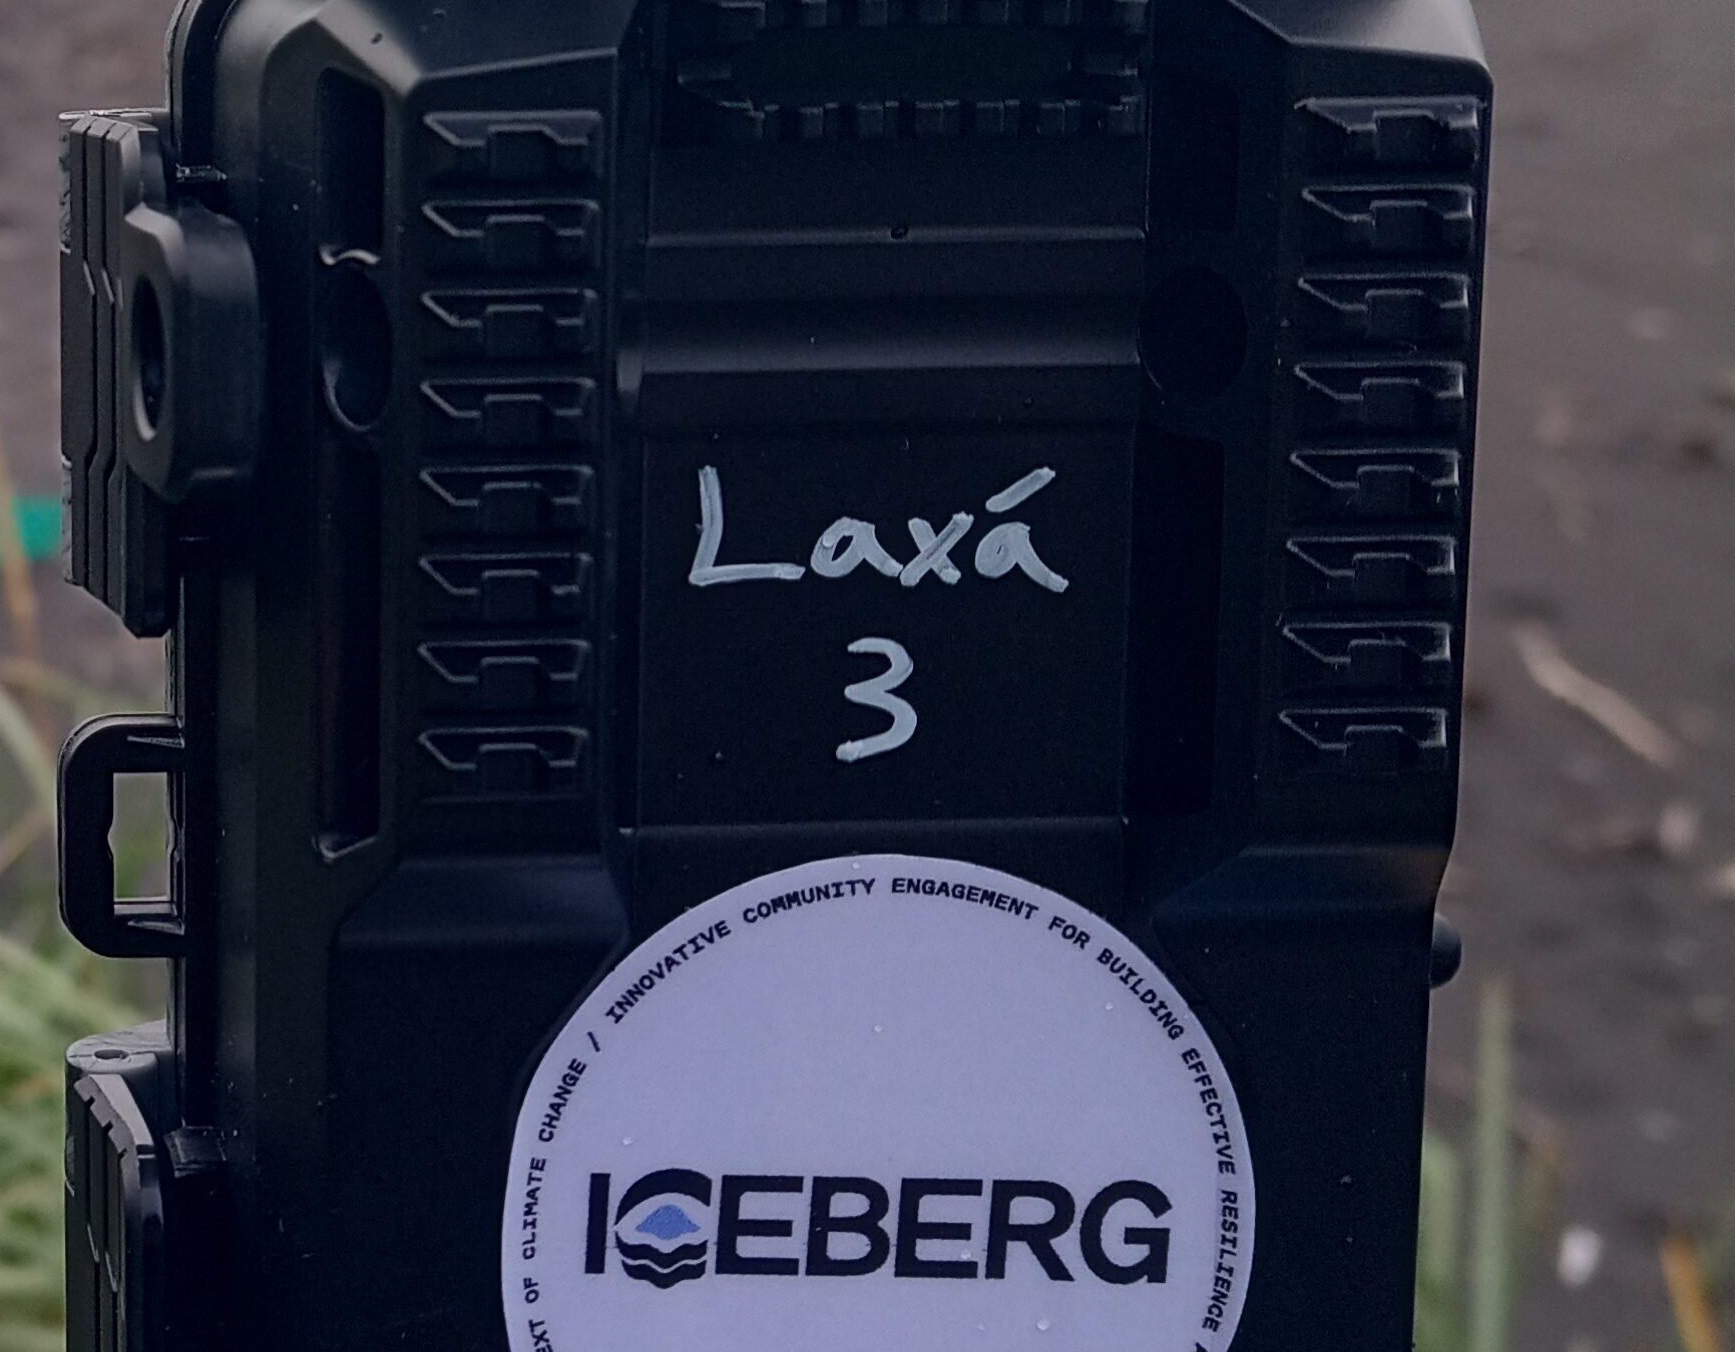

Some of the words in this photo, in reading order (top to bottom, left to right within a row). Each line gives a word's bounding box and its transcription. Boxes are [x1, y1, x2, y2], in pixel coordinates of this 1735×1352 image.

[688, 465, 1069, 592] Laxá
[836, 637, 917, 763] 3
[742, 877, 876, 924] COMMUNITY
[890, 877, 1040, 921] ENGAGEMENT
[1047, 915, 1092, 951] FOR
[604, 919, 732, 1025] INNOVATIVE
[1095, 947, 1185, 1041] BUILDING
[538, 1057, 588, 1143] CHANGE
[1180, 1047, 1237, 1175] EFFECTIVE
[521, 1156, 548, 1261] CLIMATE
[584, 1168, 1173, 1290] ICEBERG
[1201, 1188, 1239, 1333] RESILIENCE
[522, 1276, 540, 1304] OF
